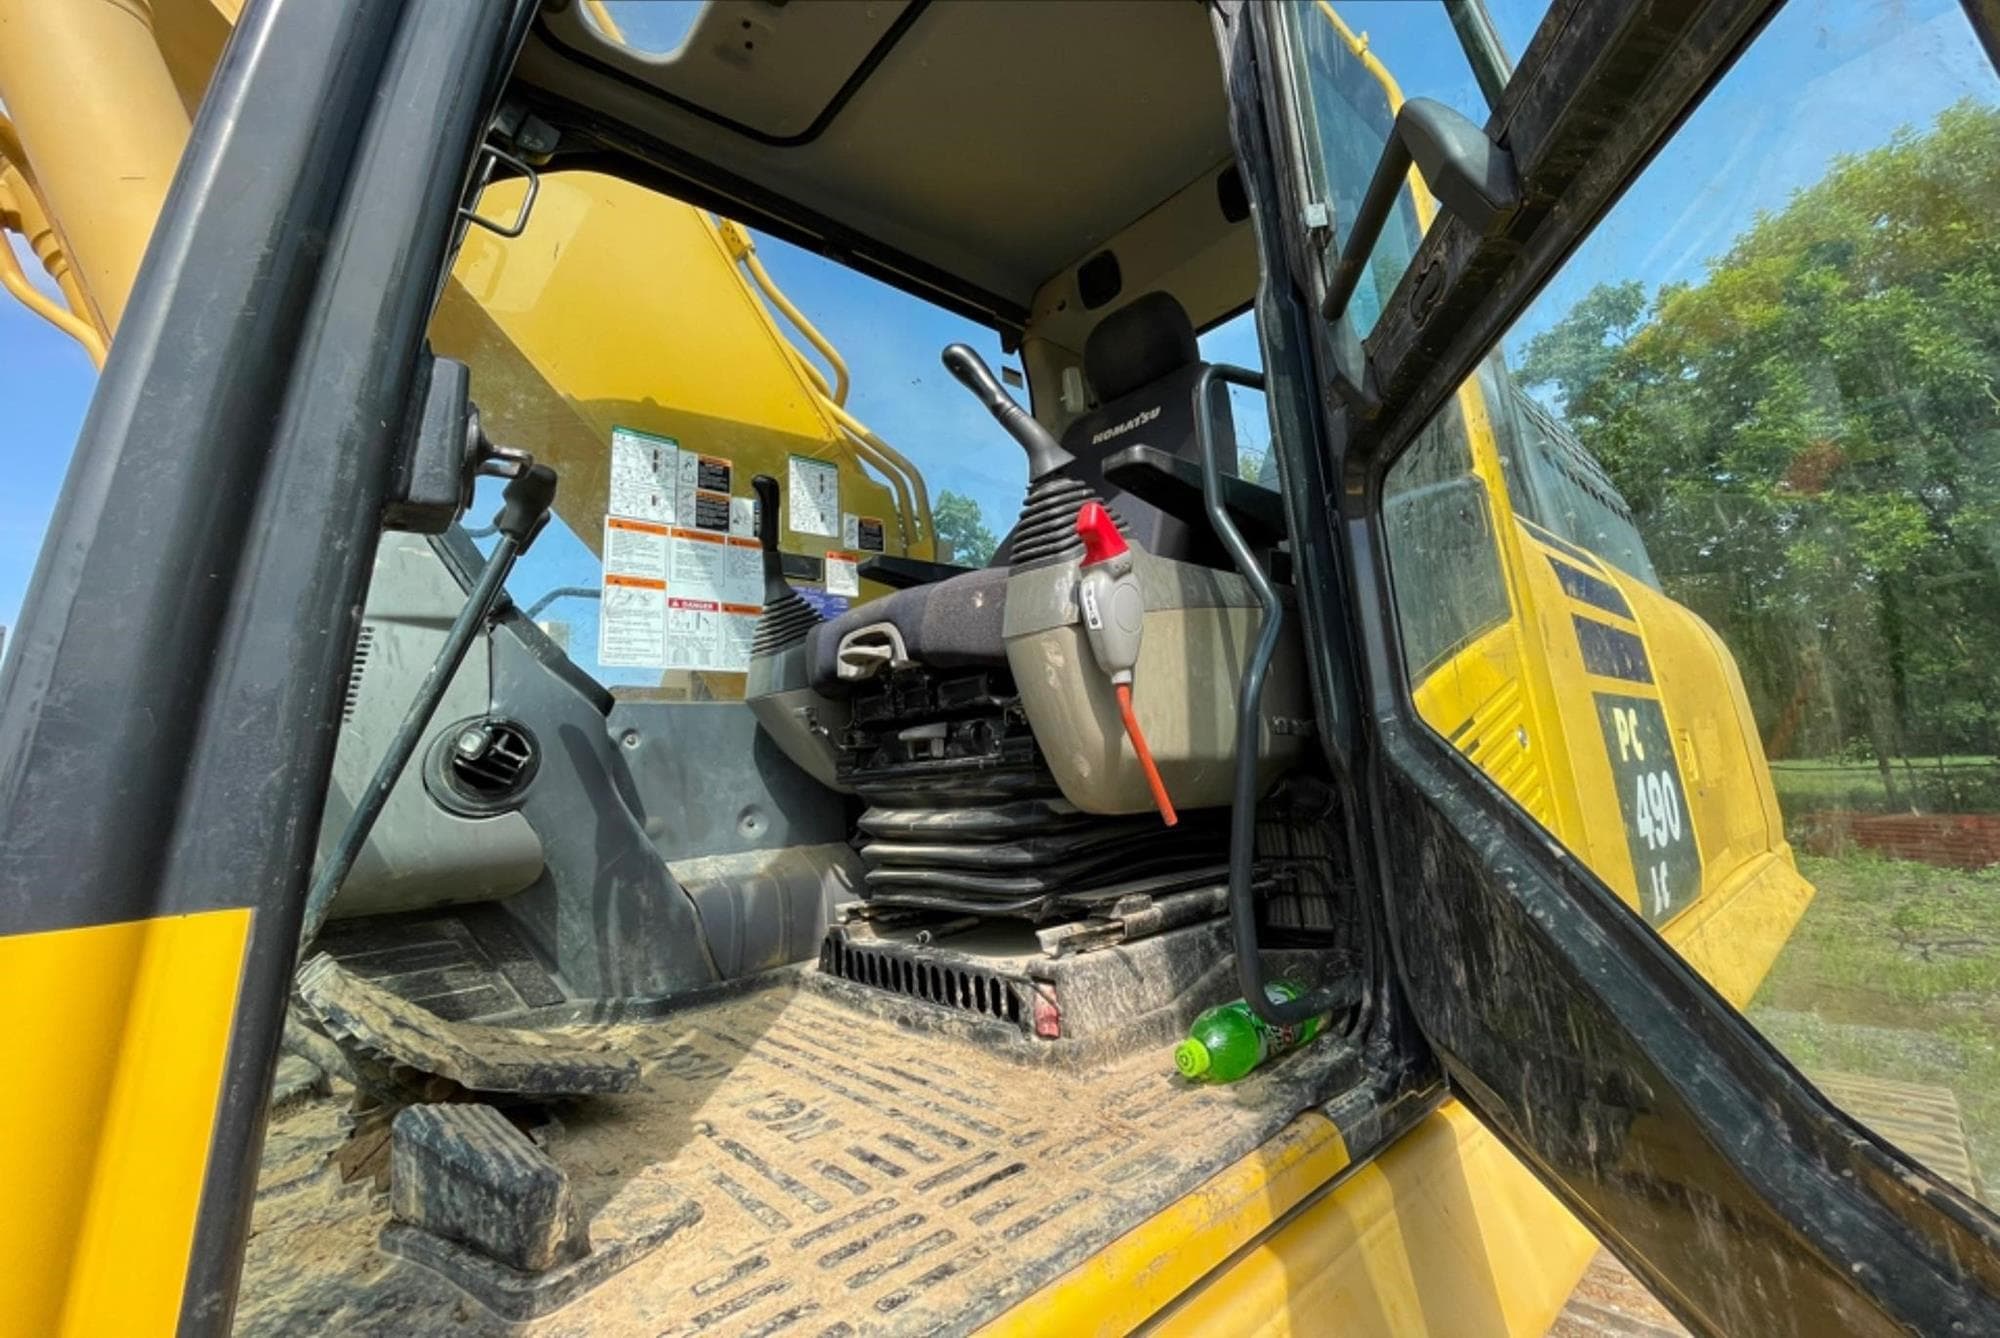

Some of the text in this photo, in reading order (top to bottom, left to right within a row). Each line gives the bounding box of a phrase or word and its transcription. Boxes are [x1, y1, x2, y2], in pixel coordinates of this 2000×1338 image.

[1092, 406, 1161, 445] KOMATSU
[681, 598, 714, 610] DANGER
[1612, 707, 1645, 762] PC
[1636, 769, 1681, 850] 490
